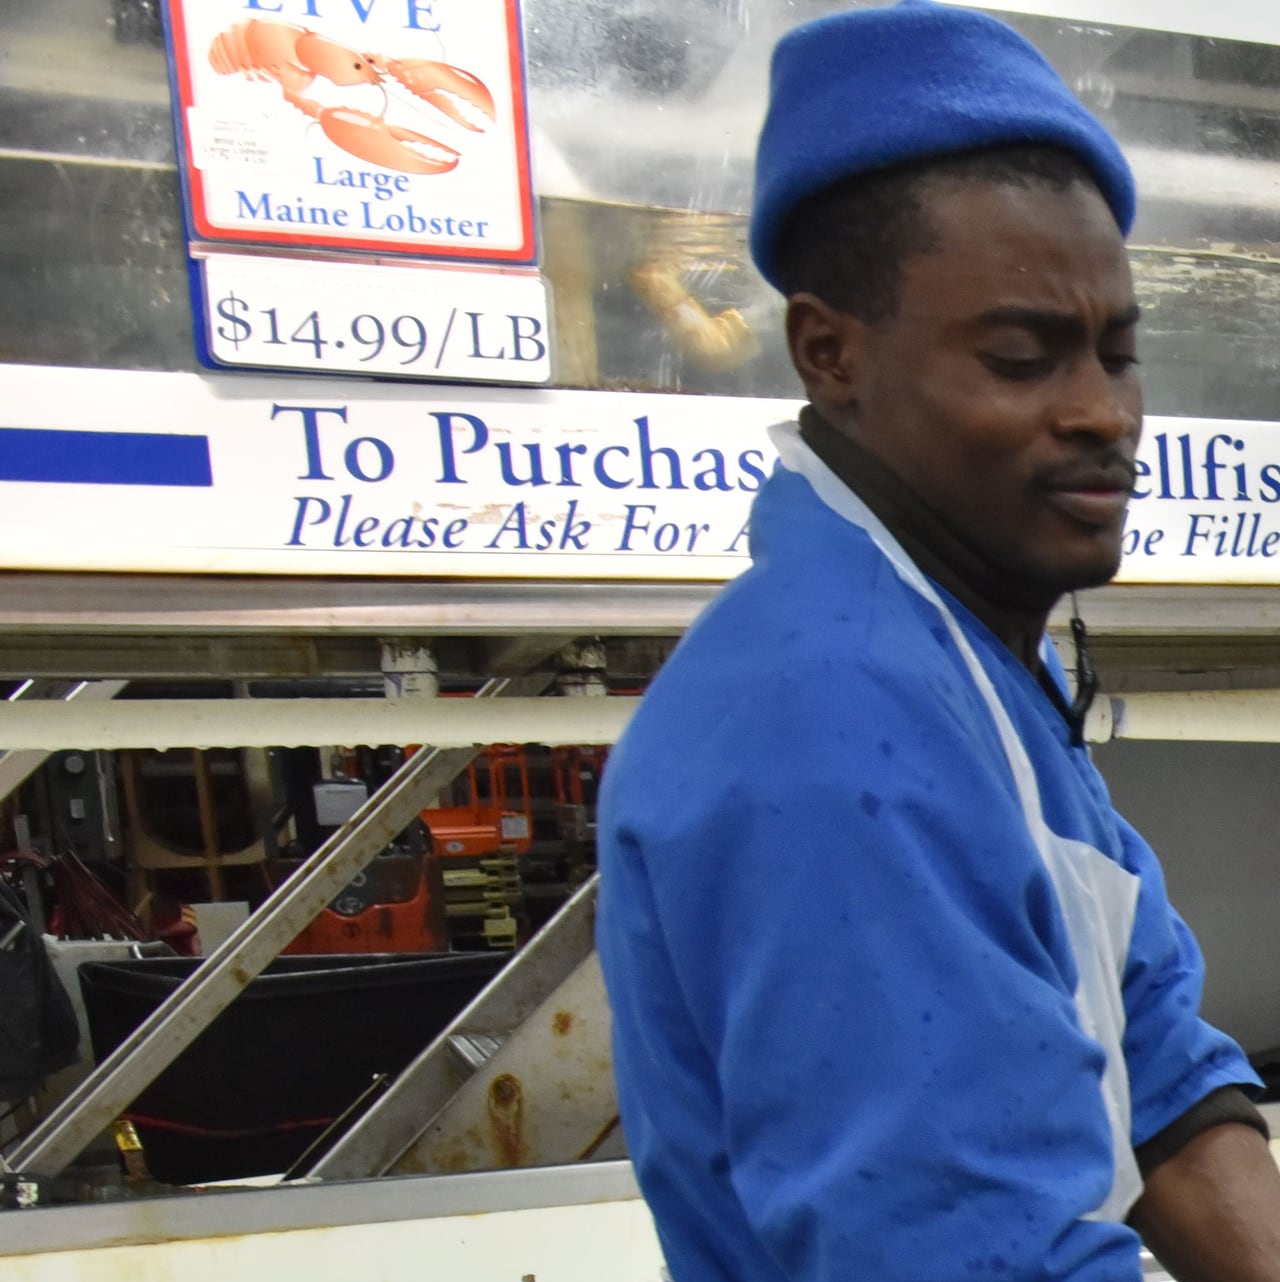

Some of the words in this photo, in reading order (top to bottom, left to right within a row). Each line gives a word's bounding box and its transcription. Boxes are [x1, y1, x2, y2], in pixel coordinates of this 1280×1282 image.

[243, 0, 441, 32] VE
[313, 156, 410, 200] Large
[236, 190, 349, 227] Maine
[361, 201, 489, 238] Lobster
[216, 290, 547, 369] $14.99/LB
[270, 402, 395, 482] To
[428, 411, 783, 492] Purchas
[284, 493, 468, 548] Please
[484, 499, 591, 551] Ask
[615, 504, 709, 555] For
[1120, 508, 1165, 556] he
